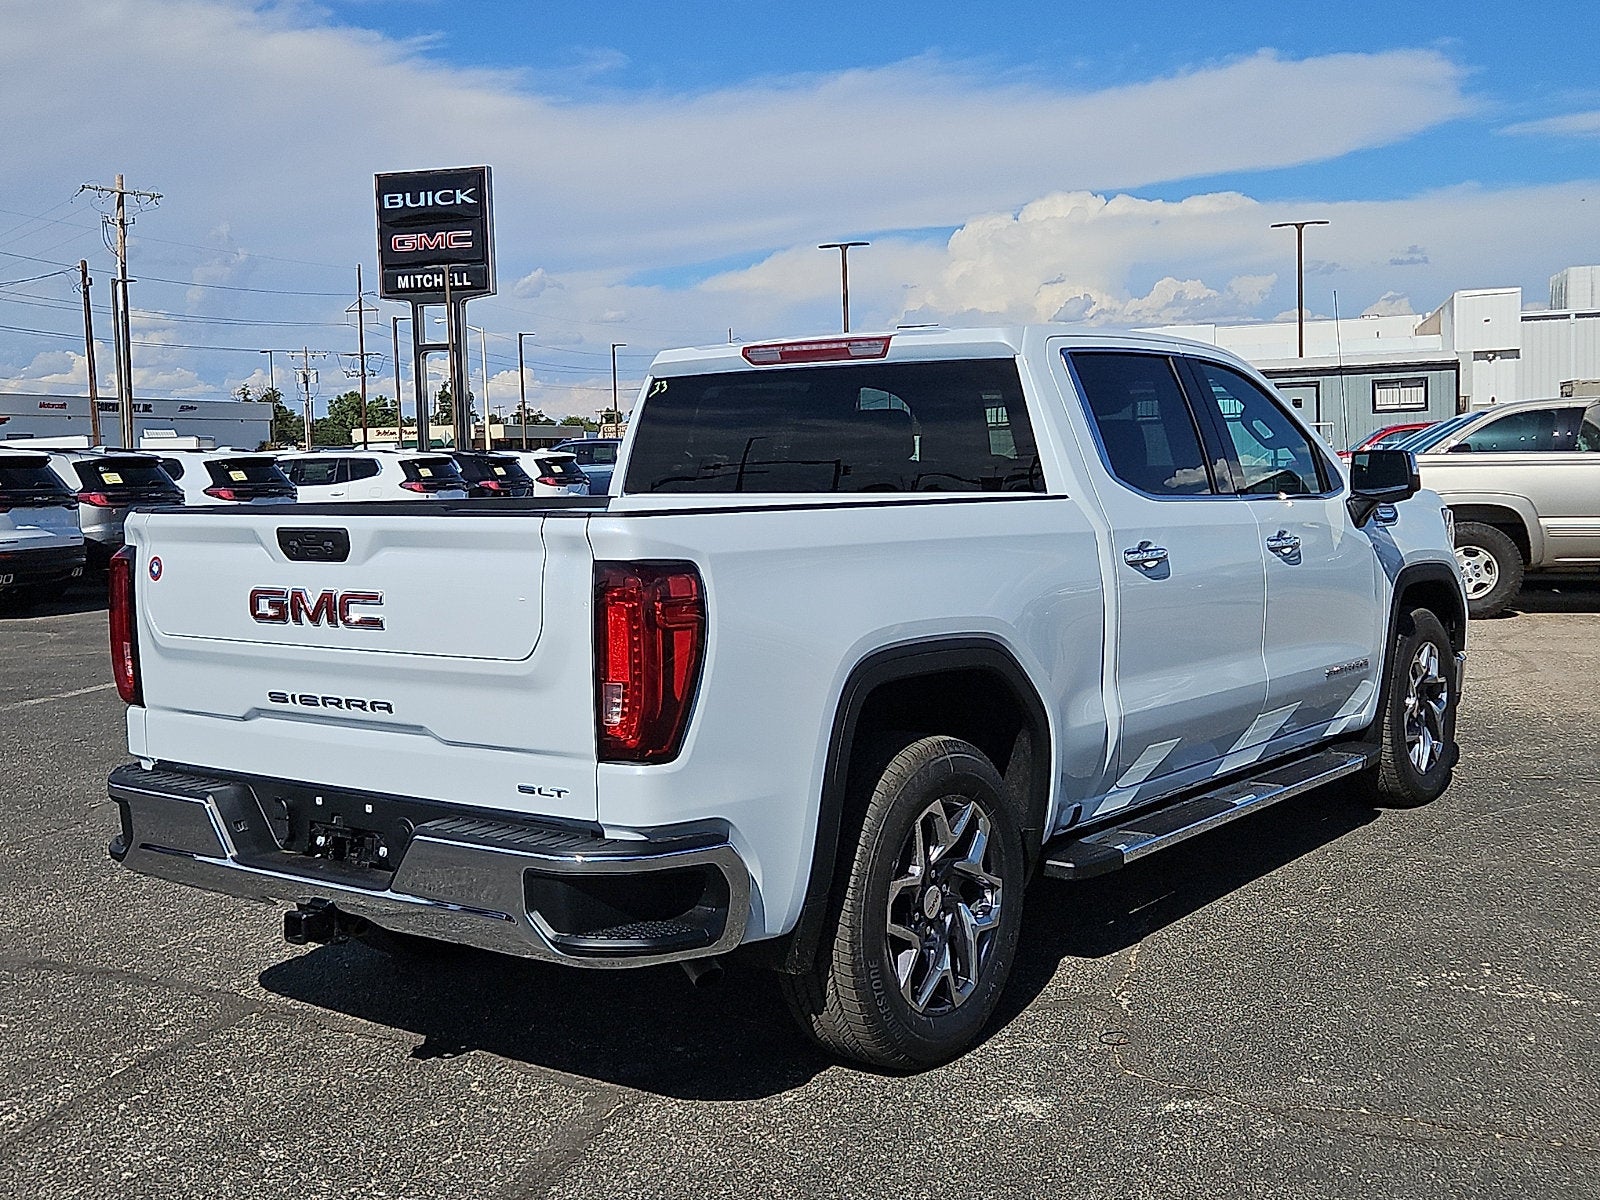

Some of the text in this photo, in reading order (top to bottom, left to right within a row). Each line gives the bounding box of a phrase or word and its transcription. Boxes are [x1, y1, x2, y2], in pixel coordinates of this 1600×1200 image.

[383, 187, 478, 209] BUICK
[391, 230, 473, 252] GMC
[249, 585, 386, 631] GMC
[267, 690, 394, 714] SIERRA
[517, 783, 570, 799] SLT
[867, 959, 909, 1044] RIDGESTONE
